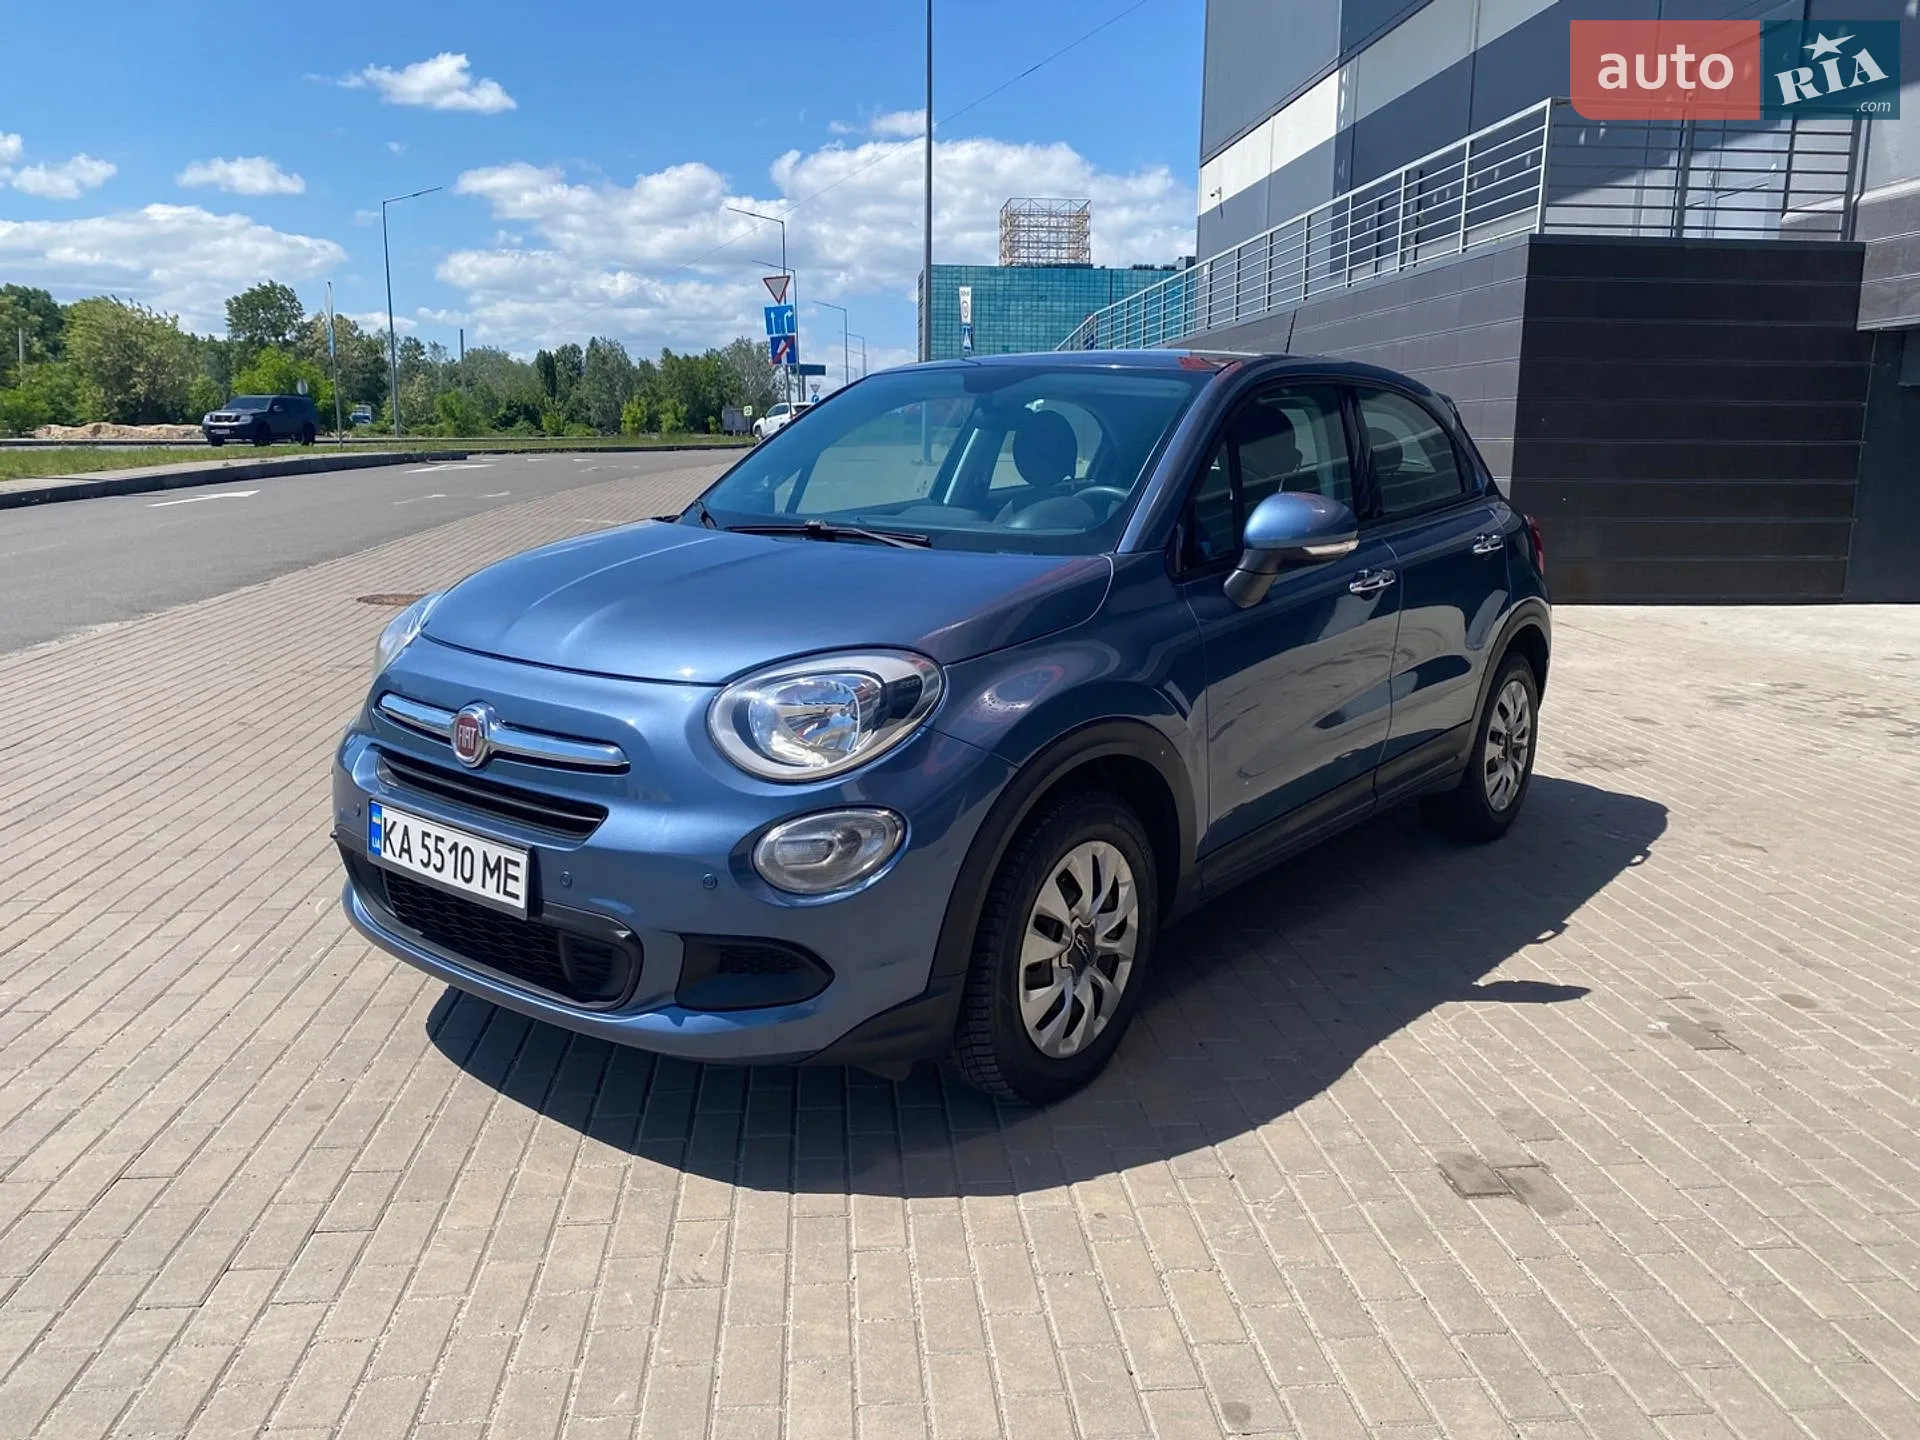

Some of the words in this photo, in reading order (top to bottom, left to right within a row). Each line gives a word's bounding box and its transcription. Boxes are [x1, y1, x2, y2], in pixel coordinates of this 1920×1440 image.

[383, 817, 413, 864] KA
[420, 830, 475, 884] 5510
[482, 850, 520, 900] ME
